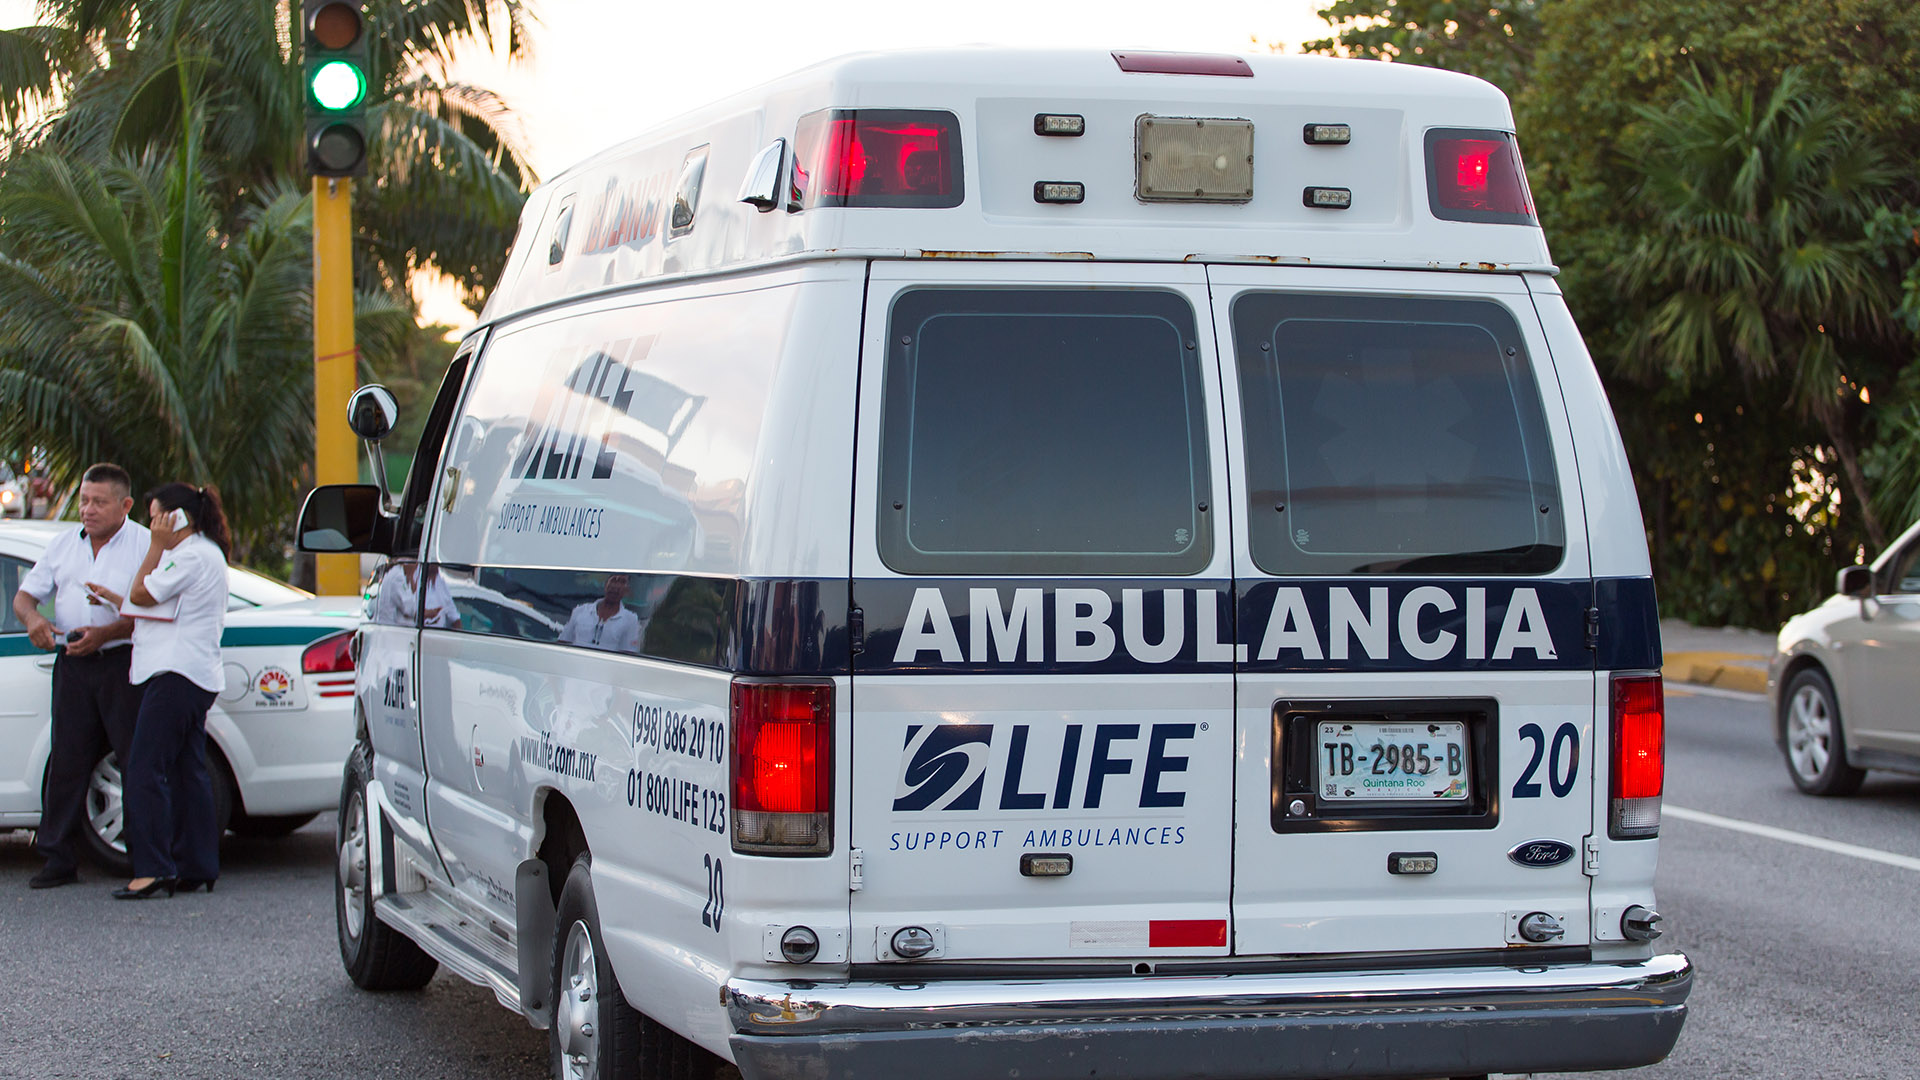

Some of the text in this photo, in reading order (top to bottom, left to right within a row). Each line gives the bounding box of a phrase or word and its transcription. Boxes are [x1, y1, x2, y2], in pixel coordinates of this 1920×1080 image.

[498, 503, 604, 539] SUPPORT AMBULANCES
[892, 586, 1558, 664] AMBULANCIA
[520, 731, 597, 782] www.life.com.mx
[631, 702, 725, 765] (998) 886 20 10
[1324, 742, 1462, 776] TB-2985-B
[1511, 722, 1580, 799] 20
[998, 723, 1197, 810] LIFE
[1363, 778, 1426, 788] Quintana Roo
[627, 768, 726, 835] 01 800 LIFE 123
[889, 826, 1186, 851] SUPPORT AMBULANCES
[1525, 844, 1560, 862] Ford
[702, 853, 725, 934] 20
